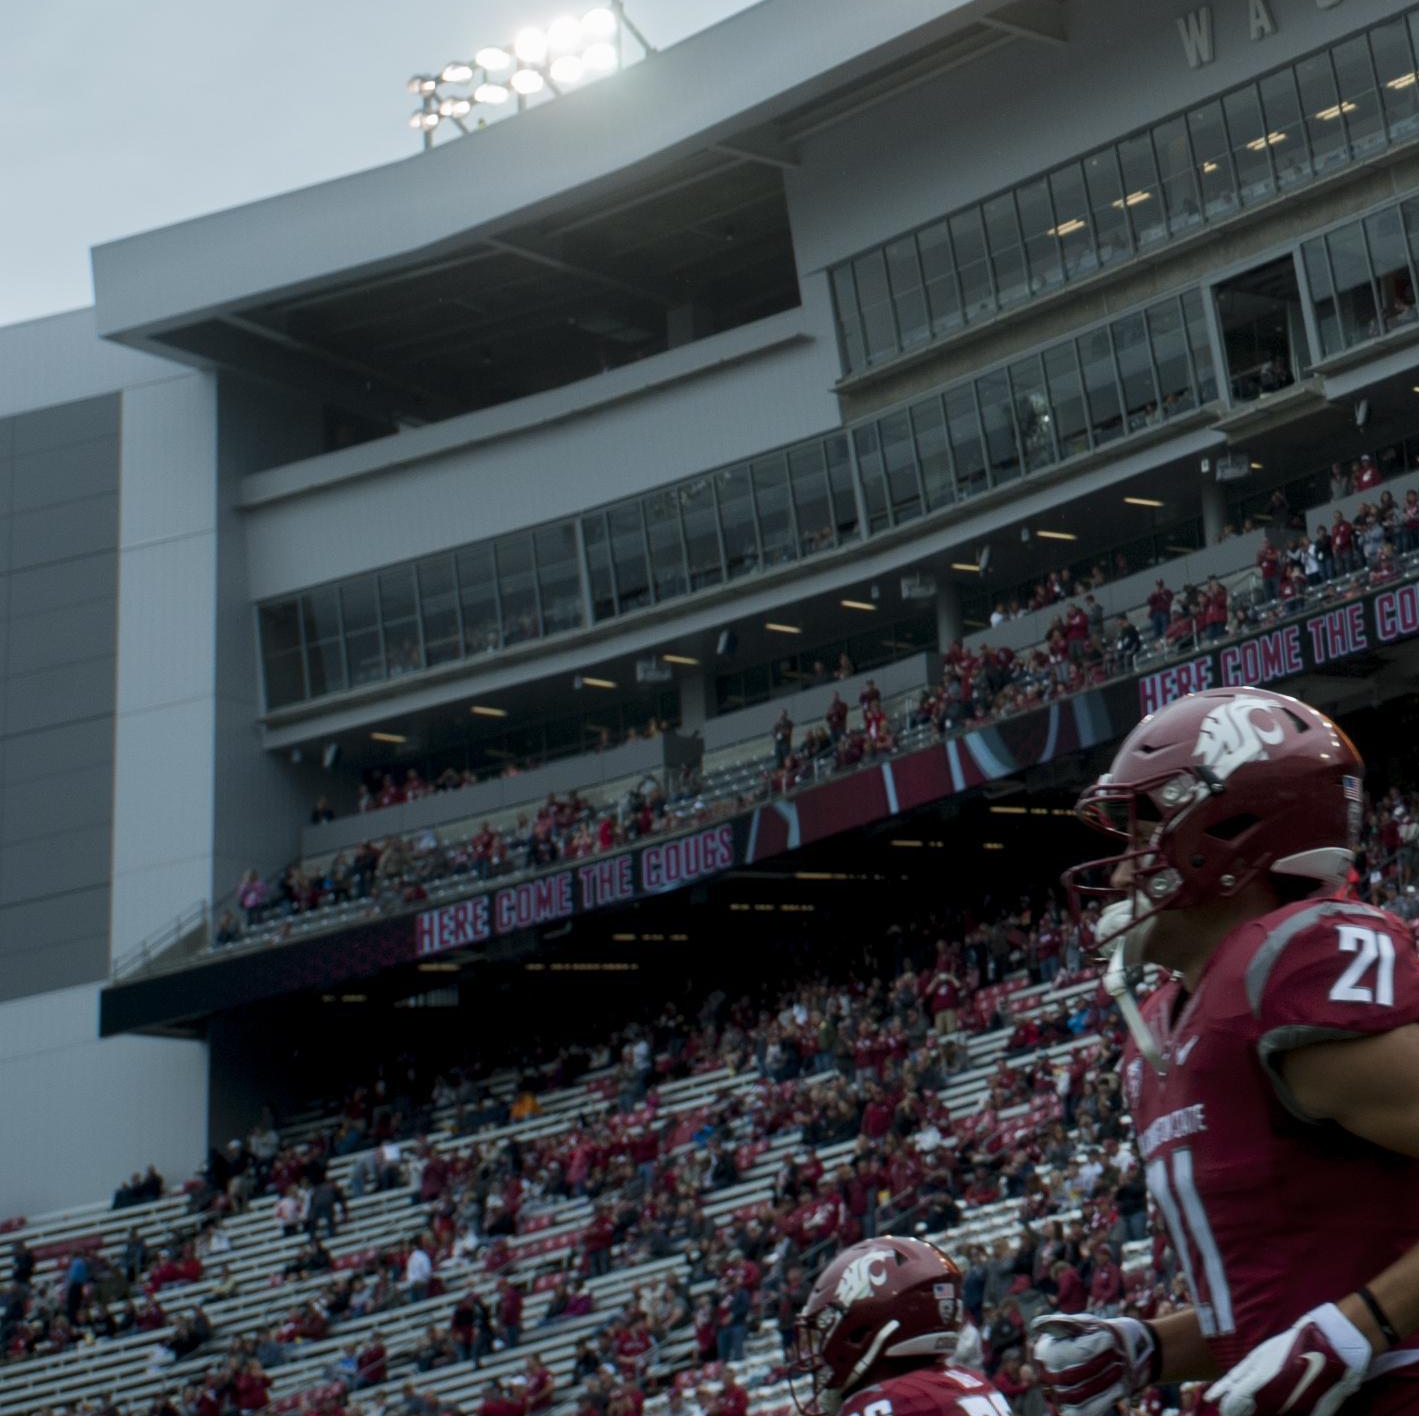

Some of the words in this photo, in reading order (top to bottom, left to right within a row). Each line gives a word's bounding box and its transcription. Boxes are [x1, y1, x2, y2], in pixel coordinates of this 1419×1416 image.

[1139, 655, 1213, 721] HERE
[1220, 623, 1303, 685] COME
[1307, 602, 1368, 665] THE
[415, 894, 490, 957] HERE
[493, 870, 573, 933] COME
[578, 853, 633, 909] THE
[641, 822, 735, 892] COUGS
[1329, 922, 1396, 1008] 21
